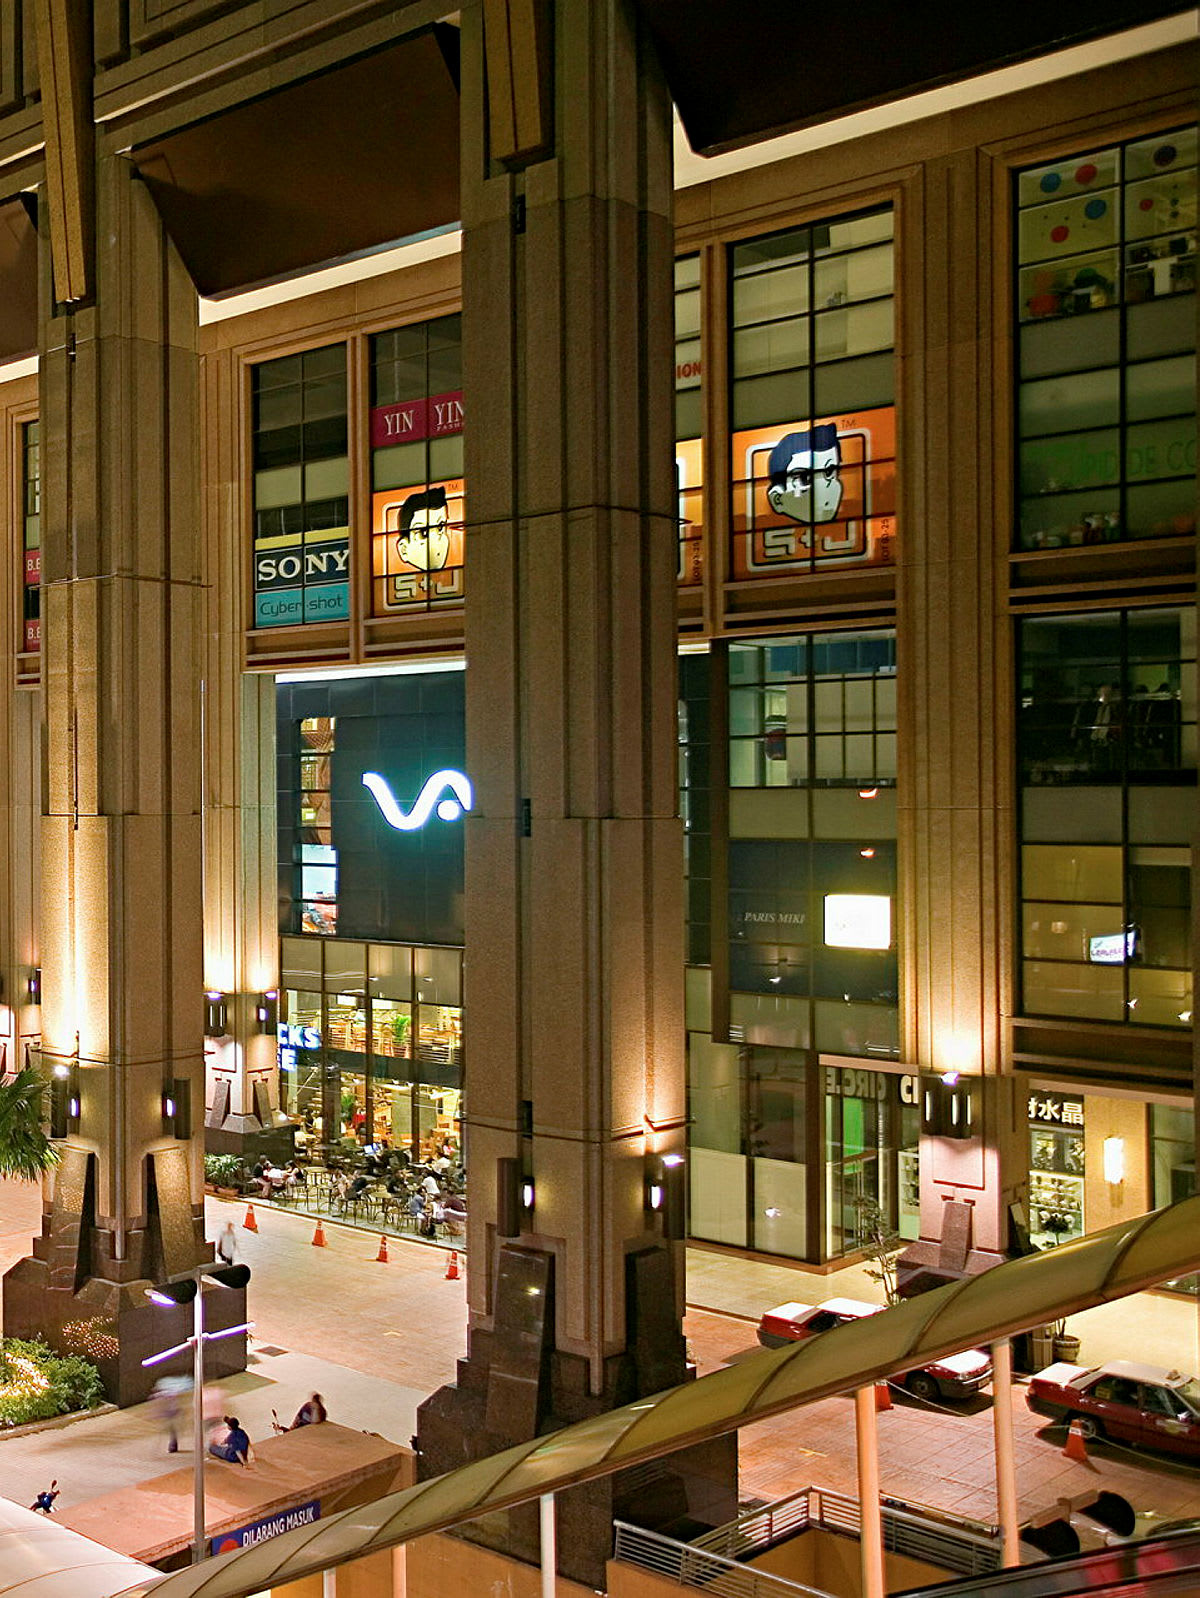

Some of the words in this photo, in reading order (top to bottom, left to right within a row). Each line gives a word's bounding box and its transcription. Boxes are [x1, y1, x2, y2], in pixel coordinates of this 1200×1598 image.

[384, 409, 415, 436] YIN
[258, 549, 350, 581] SONY
[744, 912, 776, 922] PARIS
[242, 1517, 286, 1548] DILARANG
[286, 1506, 315, 1530] MASUK
